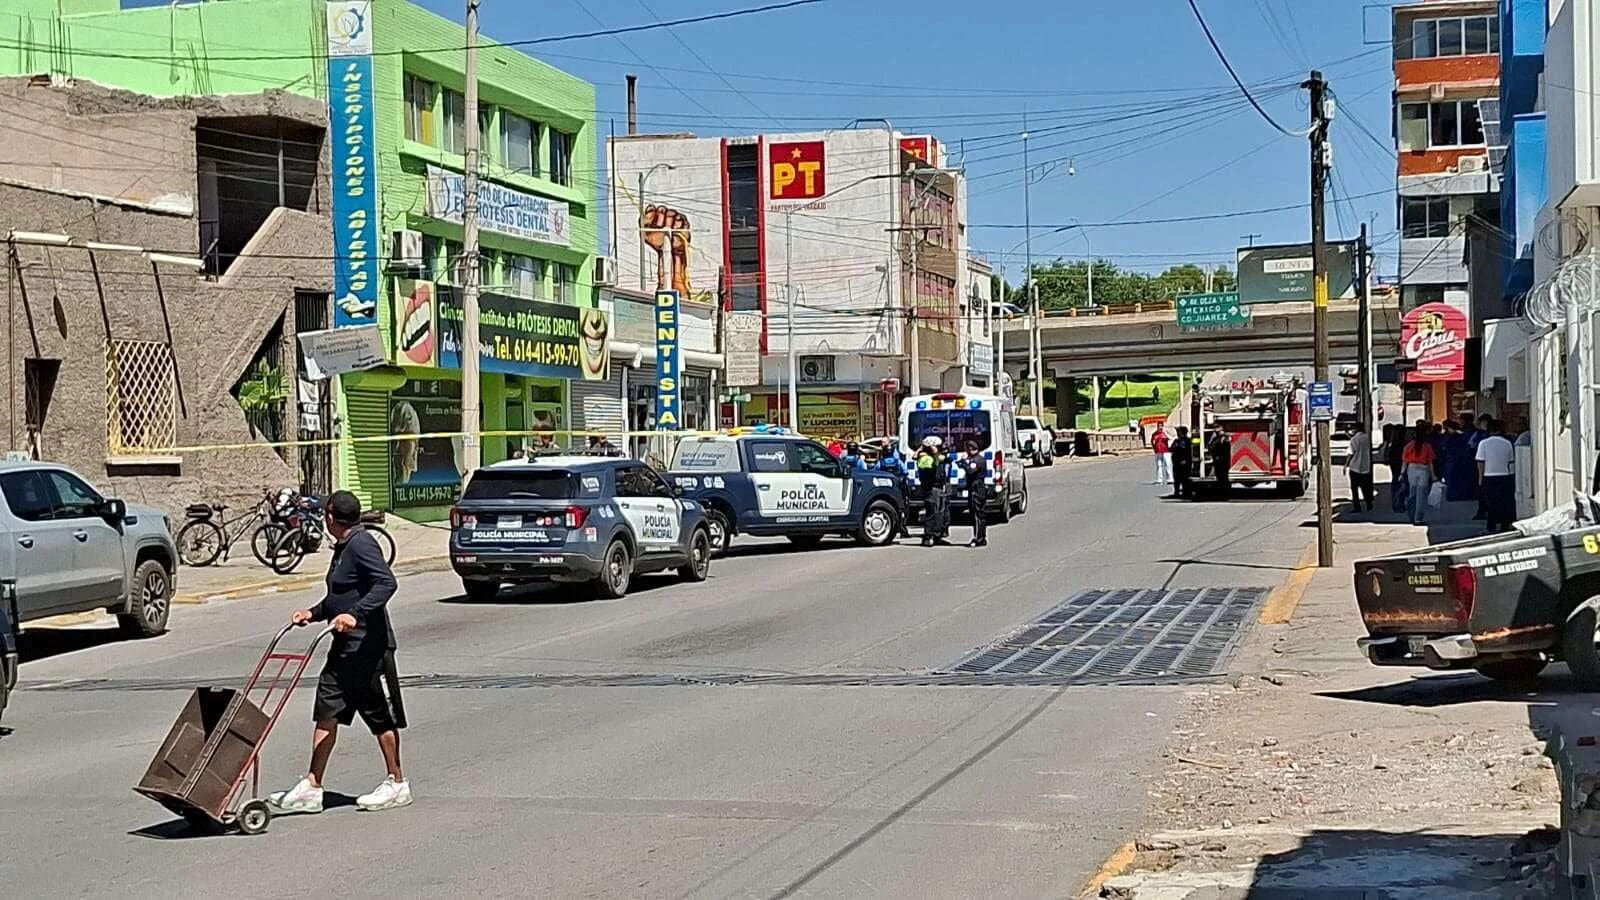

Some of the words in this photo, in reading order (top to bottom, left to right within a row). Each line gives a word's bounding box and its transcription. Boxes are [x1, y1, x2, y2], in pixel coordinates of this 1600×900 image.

[342, 63, 365, 197] INSCRIPCIONES
[774, 162, 820, 196] PT
[517, 211, 549, 233] DENTAL
[1186, 306, 1221, 314] MEXICO
[507, 311, 516, 328] de
[517, 308, 552, 335] PRÓTESIS
[553, 317, 580, 338] DENTAL
[1194, 313, 1228, 322] JUAREZ
[495, 335, 512, 361] Tel.
[657, 294, 677, 424] DENTISTA
[810, 419, 857, 427] LUCHEMOS
[781, 488, 826, 500] POLICÍA
[777, 501, 830, 510] MUNICIPAL
[472, 530, 502, 538] POLICÍA
[503, 530, 548, 538] MUNICIPAL
[642, 529, 672, 539] MUNICIPAL
[1484, 567, 1497, 577] AL
